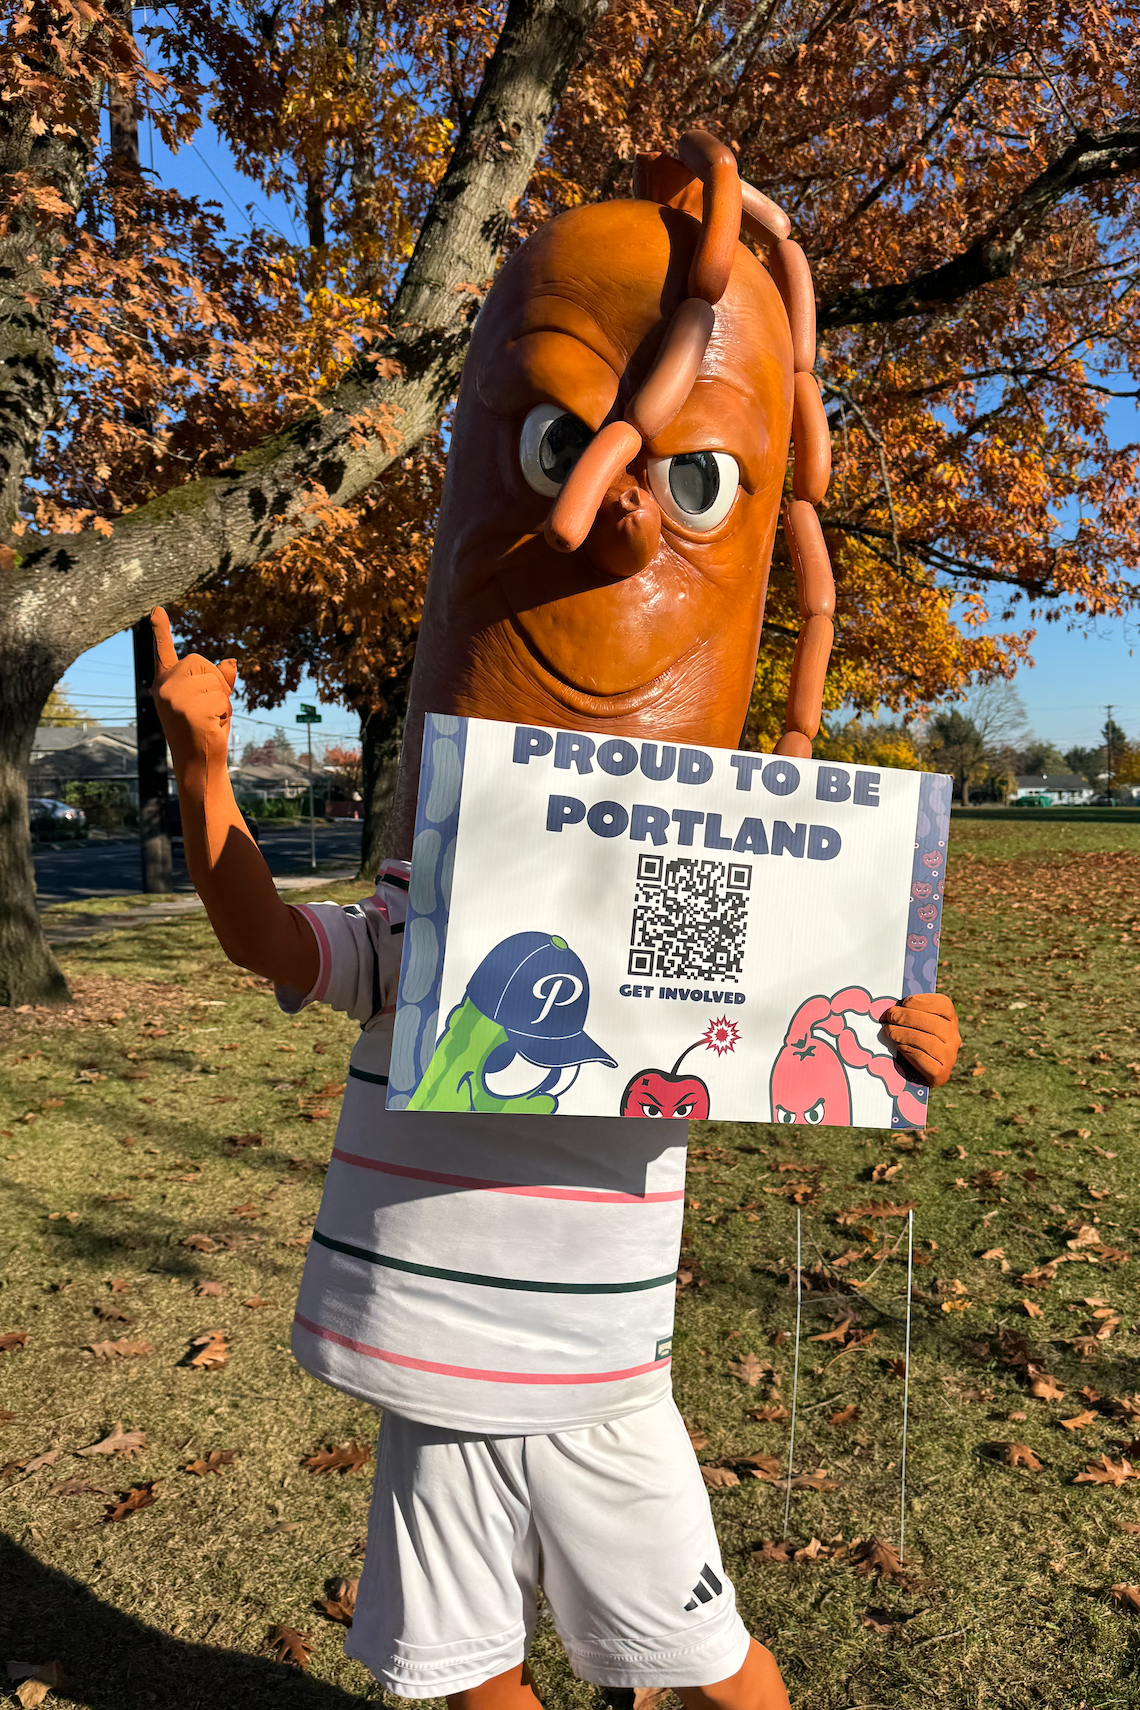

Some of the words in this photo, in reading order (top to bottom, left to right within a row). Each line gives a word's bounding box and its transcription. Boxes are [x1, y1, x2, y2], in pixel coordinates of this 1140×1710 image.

[512, 726, 714, 785] PROUD
[730, 754, 801, 796] TO
[815, 765, 881, 807] BE
[546, 794, 842, 861] PORTLAND
[531, 973, 583, 1024] P
[619, 984, 654, 998] GET
[659, 987, 746, 1005] INVOLVED
